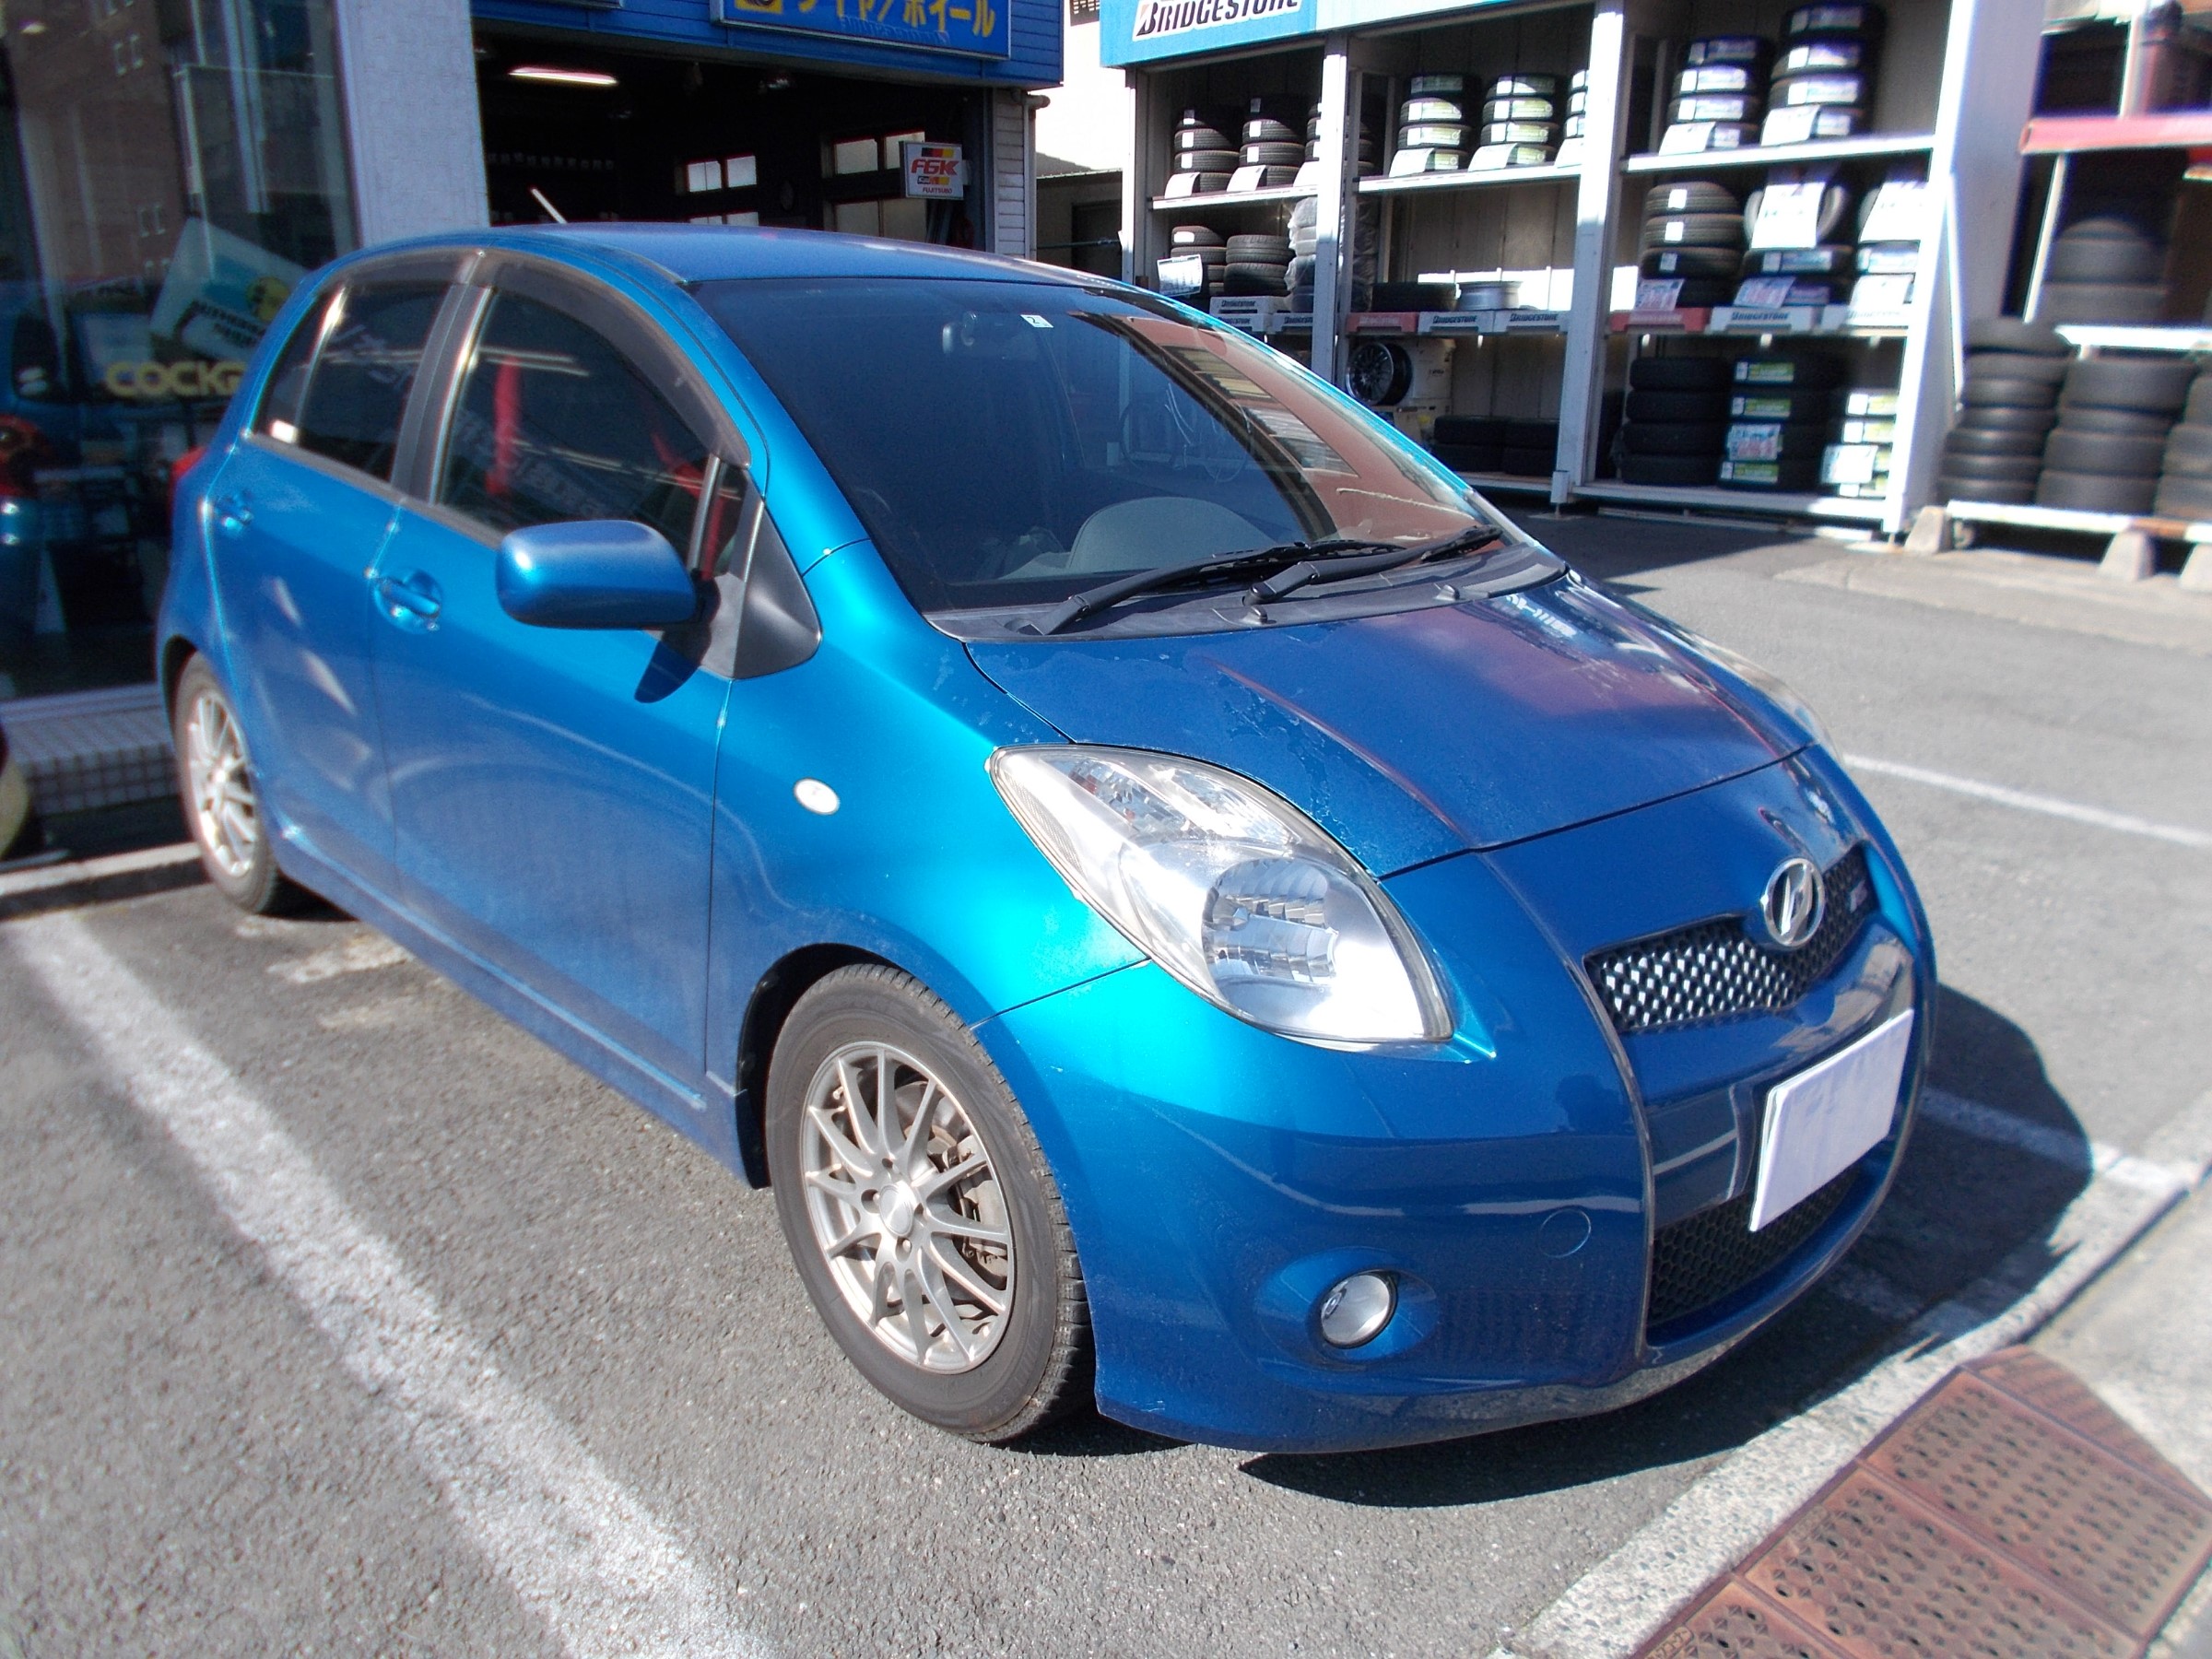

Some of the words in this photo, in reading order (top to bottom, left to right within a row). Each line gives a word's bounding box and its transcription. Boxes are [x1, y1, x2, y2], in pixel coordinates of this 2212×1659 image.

[1135, 0, 1298, 36] BRIDGESTO
[911, 159, 959, 175] FGK
[1432, 315, 1477, 324] BRIDGESTONE
[1509, 313, 1559, 322] BRIDGESTONE
